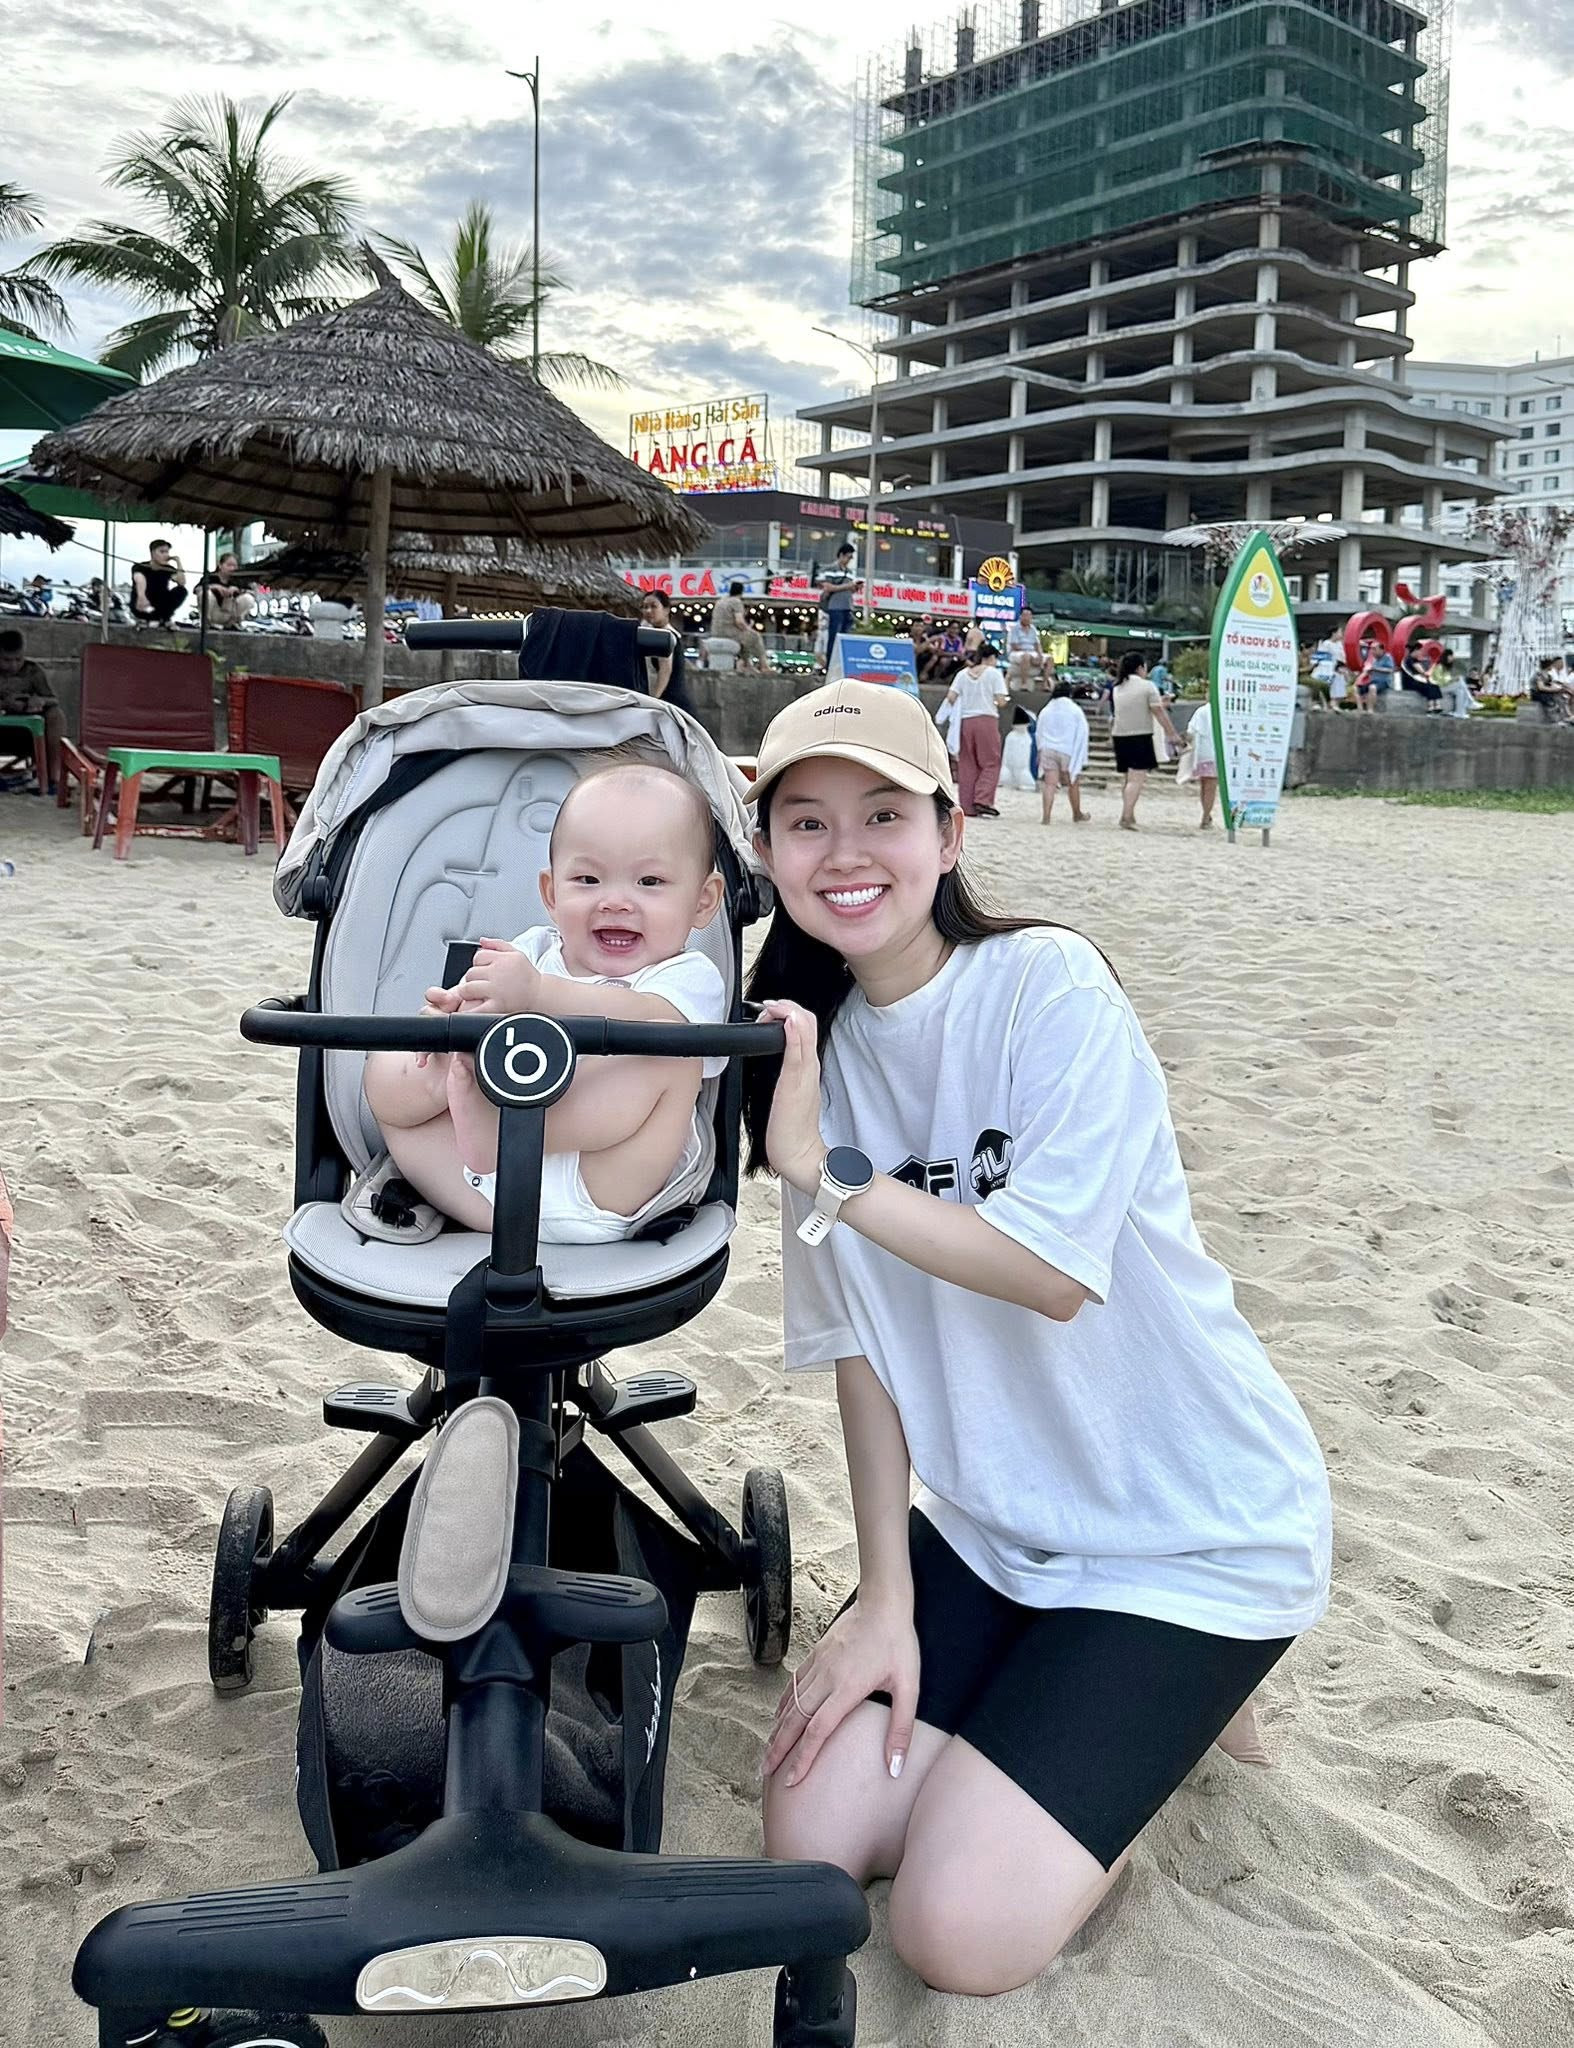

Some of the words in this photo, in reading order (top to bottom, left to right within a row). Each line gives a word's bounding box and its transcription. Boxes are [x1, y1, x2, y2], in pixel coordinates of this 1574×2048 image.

[718, 427, 758, 466] CÁ
[622, 570, 673, 596] ÀNG
[679, 567, 716, 596] CÁ
[813, 704, 862, 718] adidas
